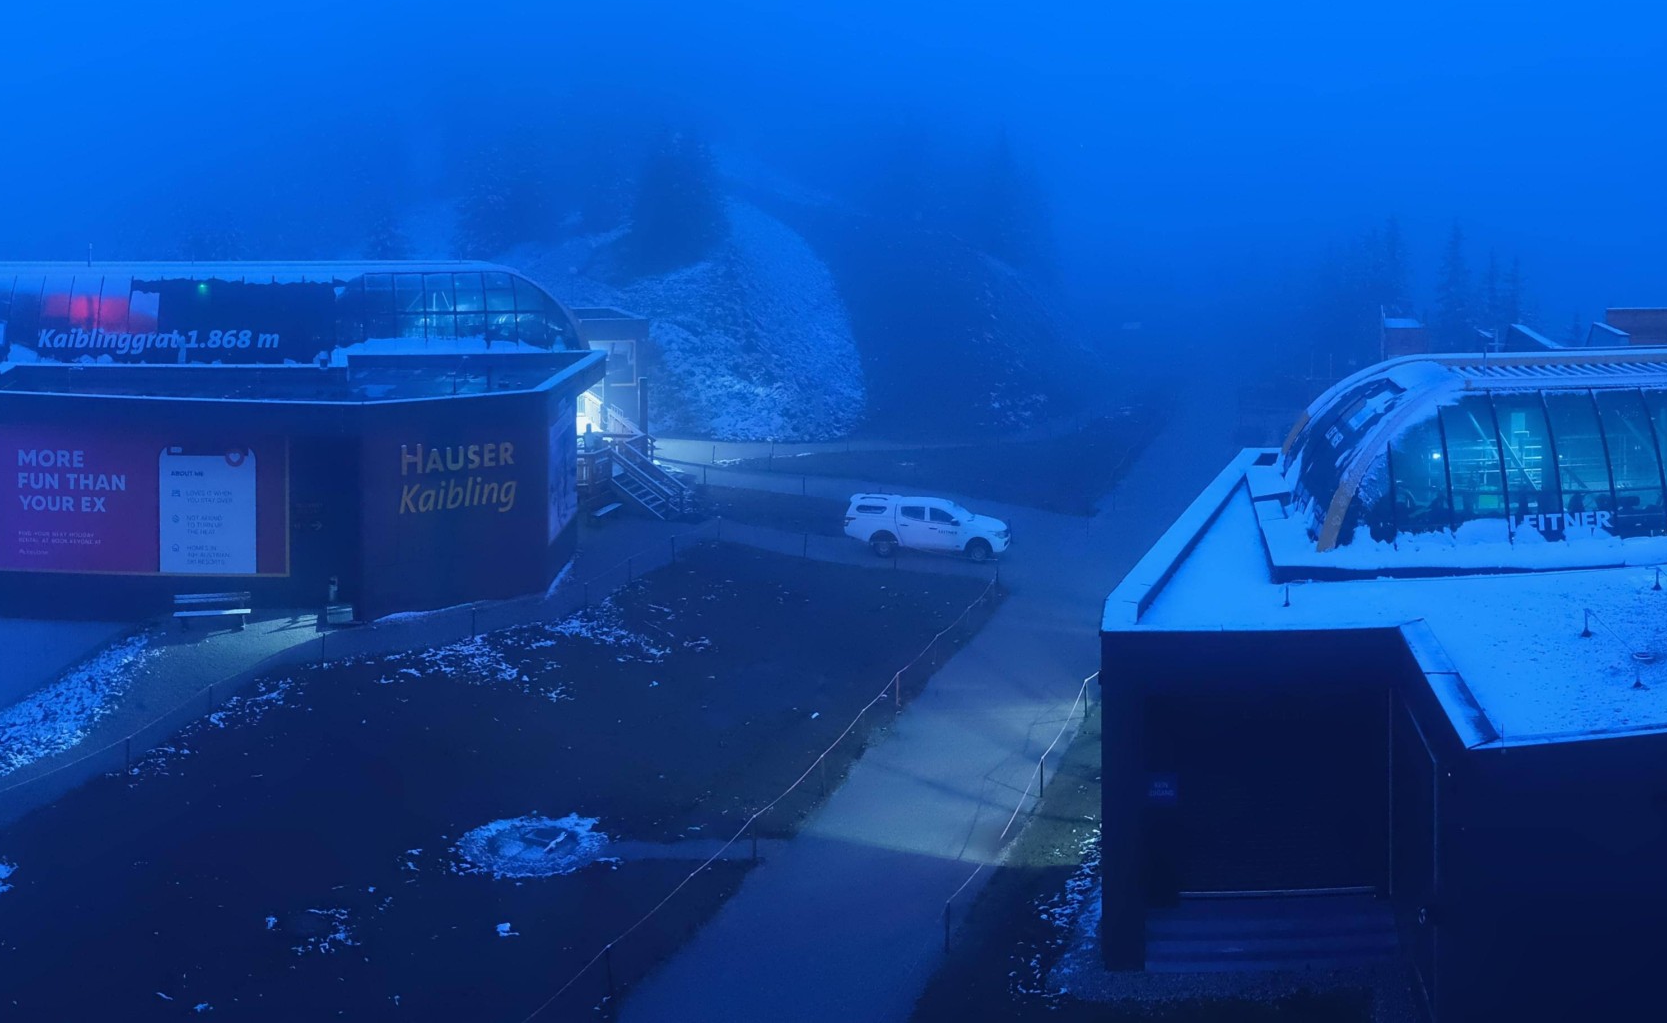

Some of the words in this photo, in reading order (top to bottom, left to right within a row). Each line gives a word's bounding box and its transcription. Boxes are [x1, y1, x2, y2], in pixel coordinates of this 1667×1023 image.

[38, 328, 183, 354] Kaiblinggrat
[186, 329, 252, 349] 1.868
[257, 332, 280, 348] m
[17, 449, 85, 468] MORE
[17, 472, 59, 490] FUN
[66, 473, 126, 491] THAN
[19, 495, 75, 512] YOUR
[81, 496, 107, 513] EX
[399, 476, 518, 514] Kaibling
[1509, 510, 1615, 533] LEITNER
